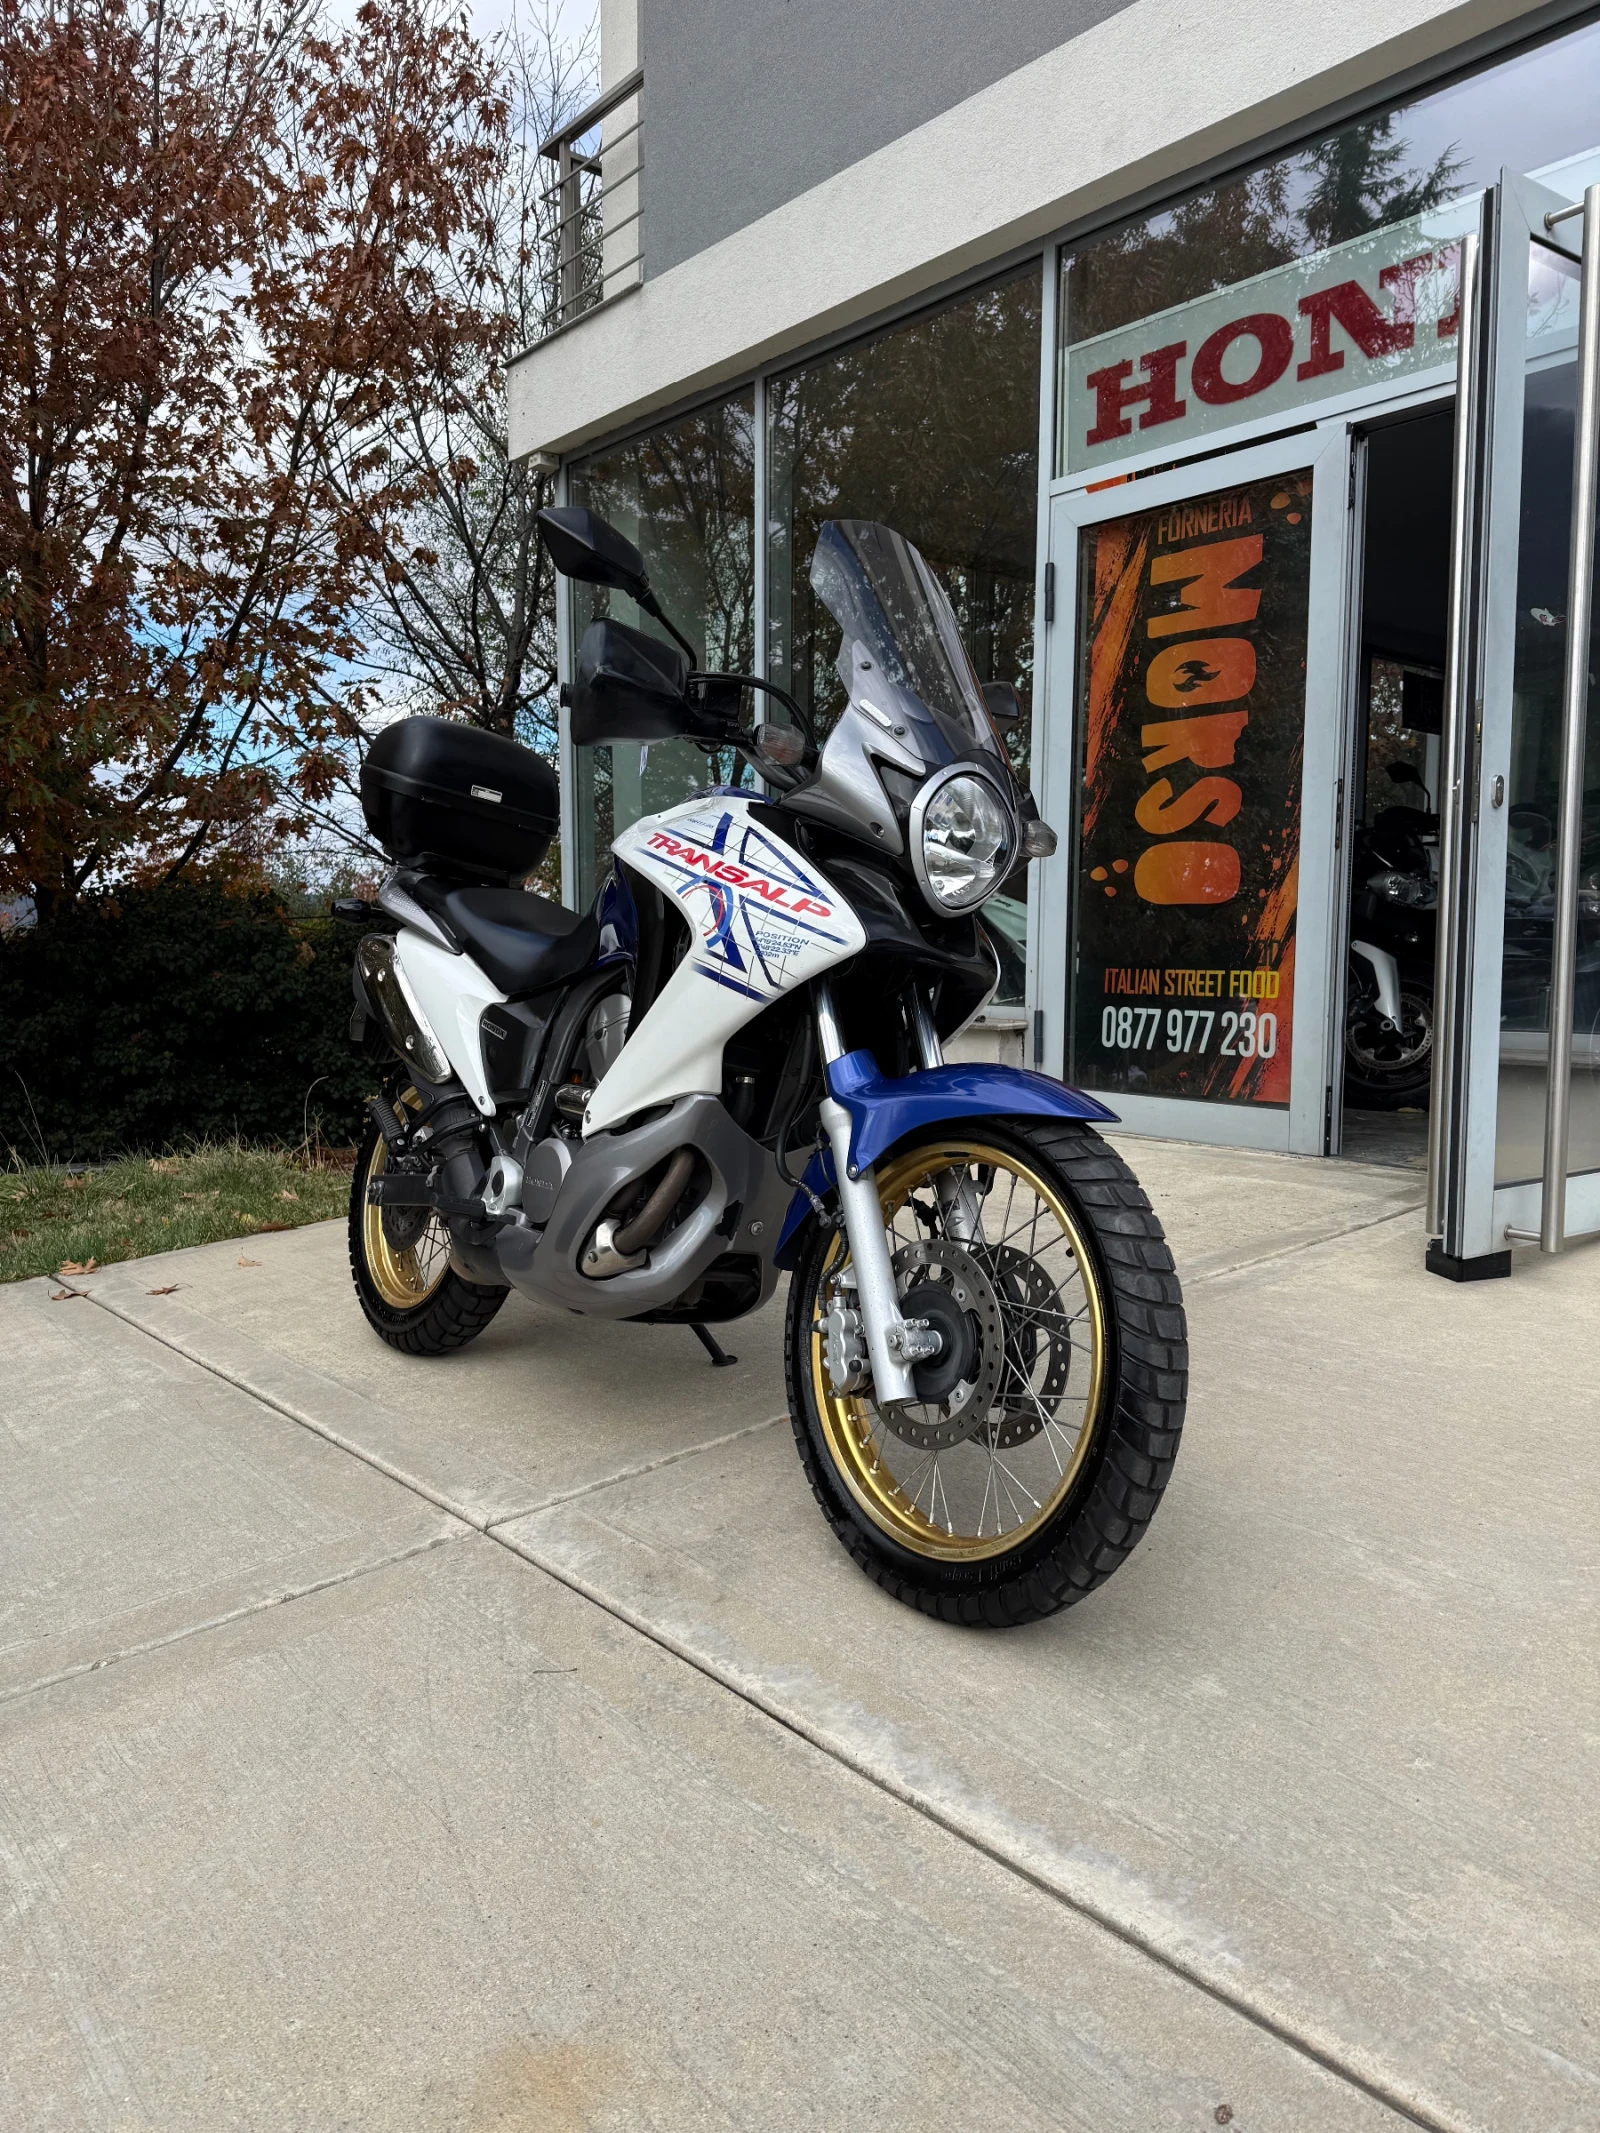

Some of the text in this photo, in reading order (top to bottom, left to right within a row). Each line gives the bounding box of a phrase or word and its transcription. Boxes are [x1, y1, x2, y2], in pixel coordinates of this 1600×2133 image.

[1086, 243, 1460, 447] HON
[1157, 498, 1252, 545] FORNERIA
[1133, 533, 1264, 905] MORSO
[646, 832, 832, 918] TRANSALP
[755, 930, 810, 945] POSITION
[1103, 968, 1280, 999] ITALIAN STREET FOOD
[1101, 1005, 1277, 1059] 0877 977 230
